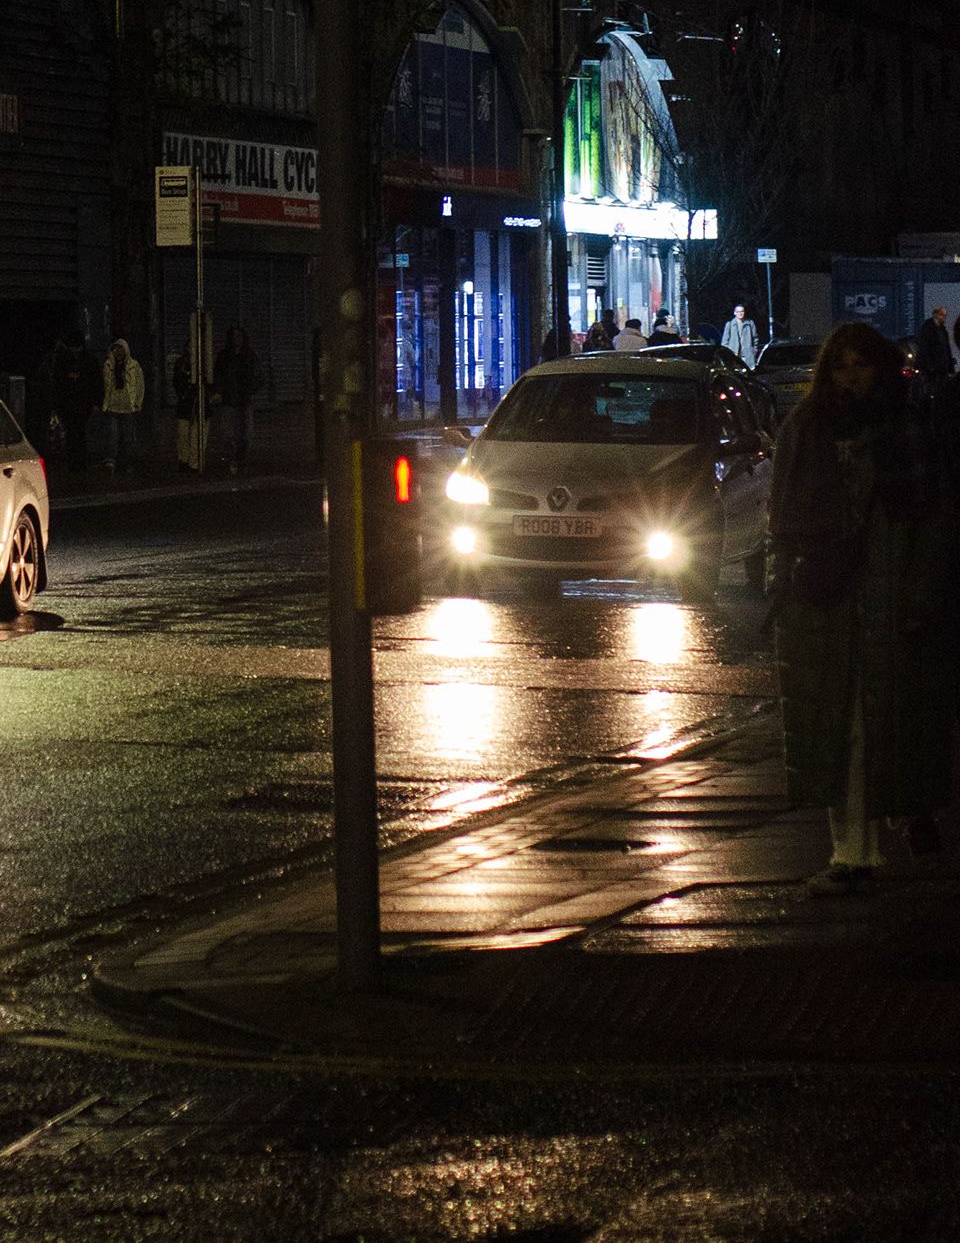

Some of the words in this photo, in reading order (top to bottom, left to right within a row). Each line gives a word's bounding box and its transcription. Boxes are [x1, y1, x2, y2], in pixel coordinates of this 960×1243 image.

[166, 136, 230, 184] HARRY
[235, 144, 278, 189] HALL
[845, 295, 887, 307] PACS
